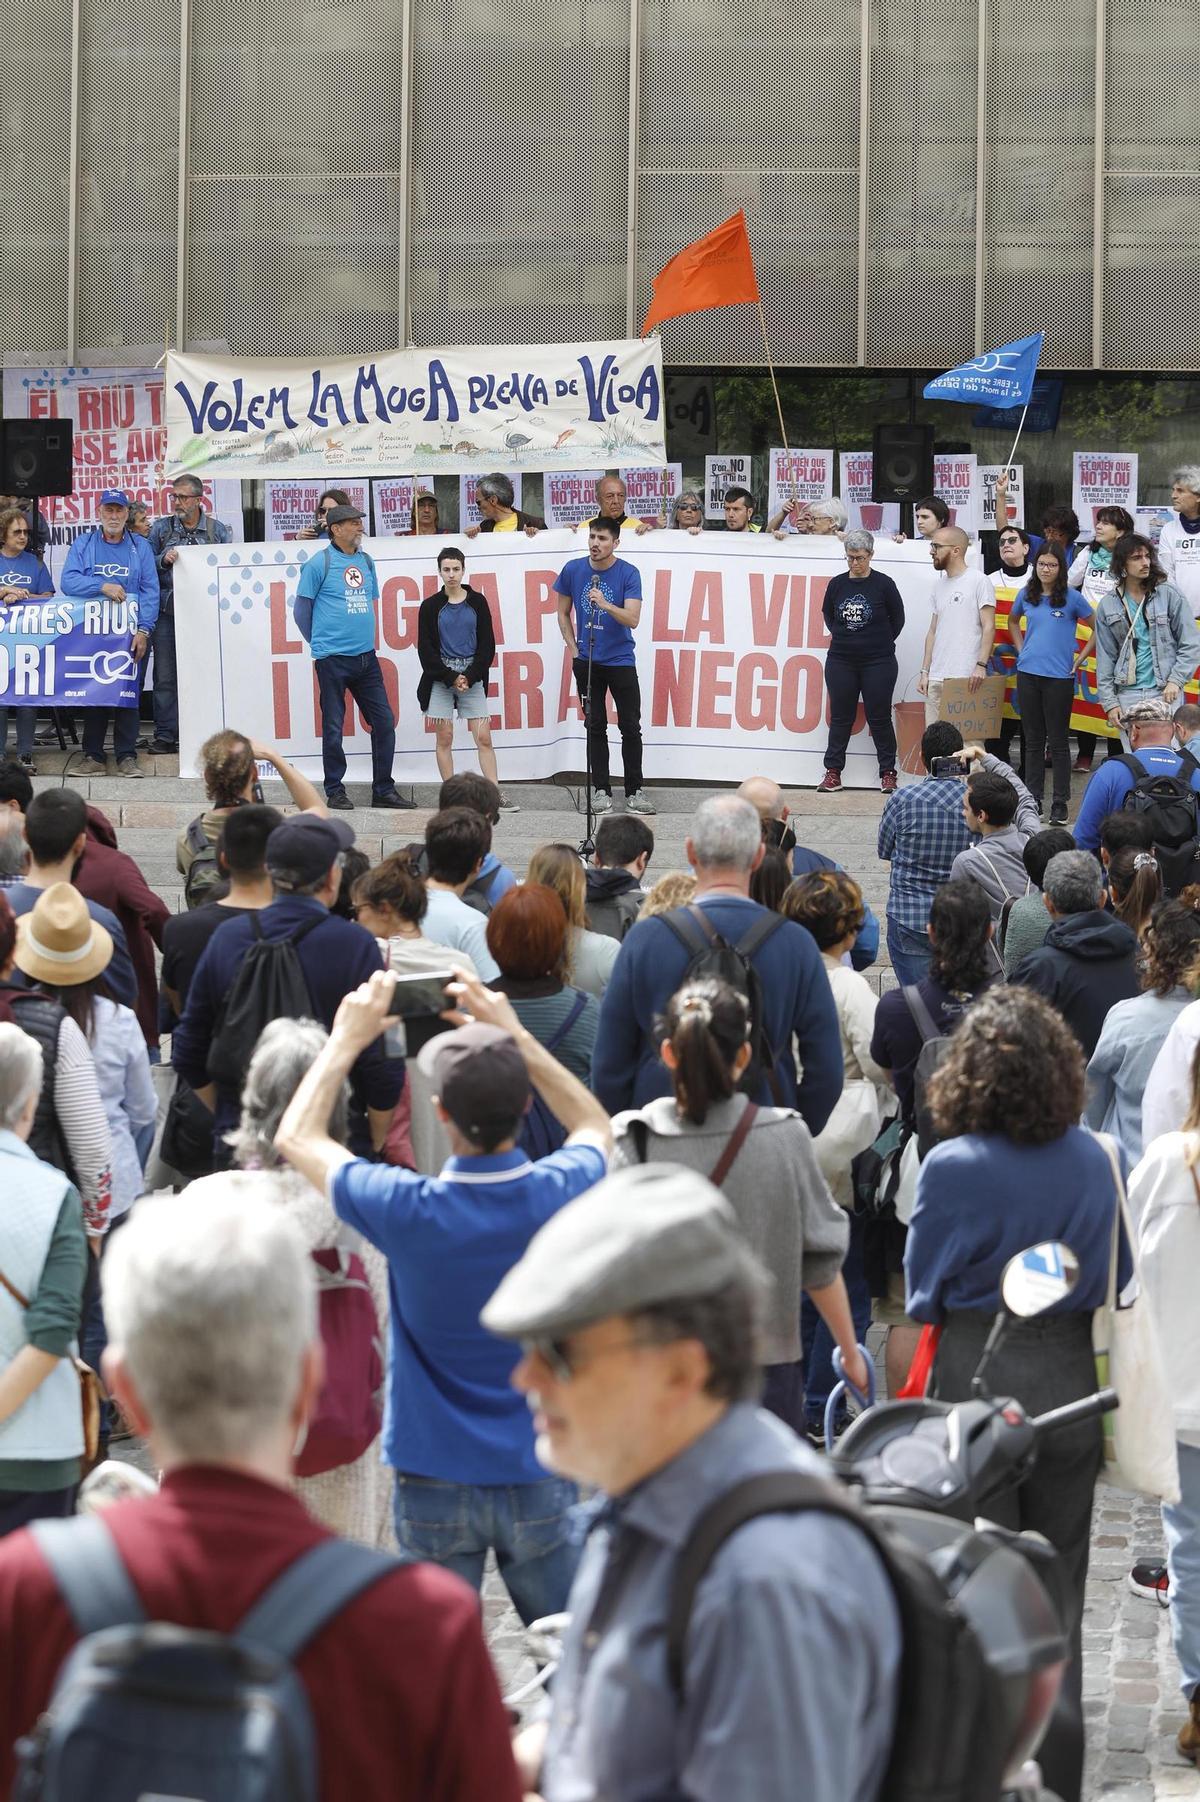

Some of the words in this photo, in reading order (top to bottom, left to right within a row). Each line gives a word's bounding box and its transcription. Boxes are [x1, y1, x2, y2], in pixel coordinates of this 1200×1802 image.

[174, 378, 299, 434] VOLEM
[308, 370, 350, 427] LA
[354, 359, 460, 424] MUGA
[468, 372, 548, 414] PLENA
[556, 379, 578, 396] DE
[78, 384, 135, 431] RIU
[127, 428, 168, 464] AIG
[730, 459, 744, 472] NO
[812, 459, 825, 468] QUE
[956, 464, 970, 473] QUE
[1116, 462, 1130, 471] QUE
[777, 468, 792, 482] NO
[796, 468, 825, 482] PLOU
[848, 472, 864, 485] NO
[941, 474, 970, 488] PLOU
[1081, 472, 1096, 486] NO
[1101, 472, 1130, 486] PLOU
[305, 489, 318, 498] QUE
[627, 483, 642, 497] NO
[711, 489, 724, 502] NO
[382, 498, 396, 512] NO
[552, 491, 567, 505] NO
[273, 500, 287, 513] NO
[1182, 538, 1195, 549] GT
[1092, 570, 1105, 578] GT
[652, 570, 725, 644] LA
[84, 600, 139, 635] RIUS
[272, 662, 291, 740] I
